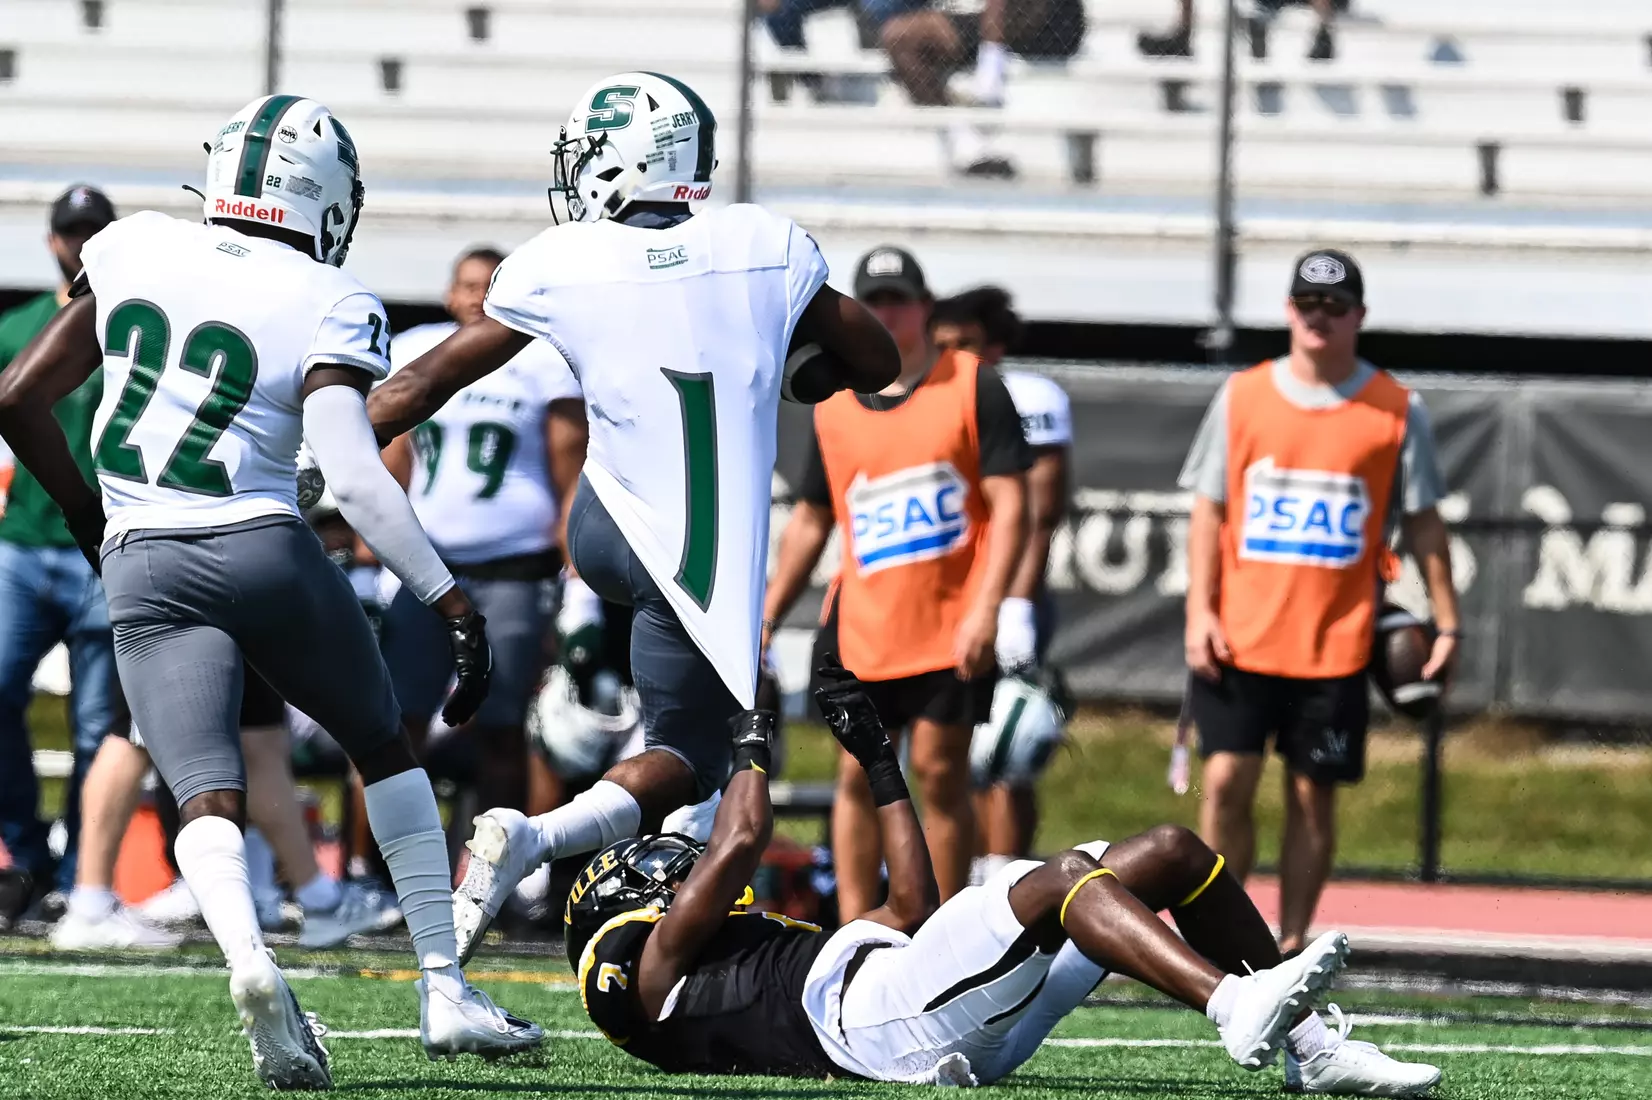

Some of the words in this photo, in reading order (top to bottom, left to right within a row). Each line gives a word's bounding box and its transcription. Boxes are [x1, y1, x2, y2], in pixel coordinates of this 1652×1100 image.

[585, 85, 641, 134] S
[671, 111, 698, 129] JERRY
[265, 174, 282, 188] 22
[215, 198, 285, 224] Riddell
[647, 247, 689, 264] PSAC
[93, 298, 259, 497] 22
[660, 366, 720, 614] 1
[852, 485, 963, 540] PSAC
[1249, 493, 1363, 538] PSAC
